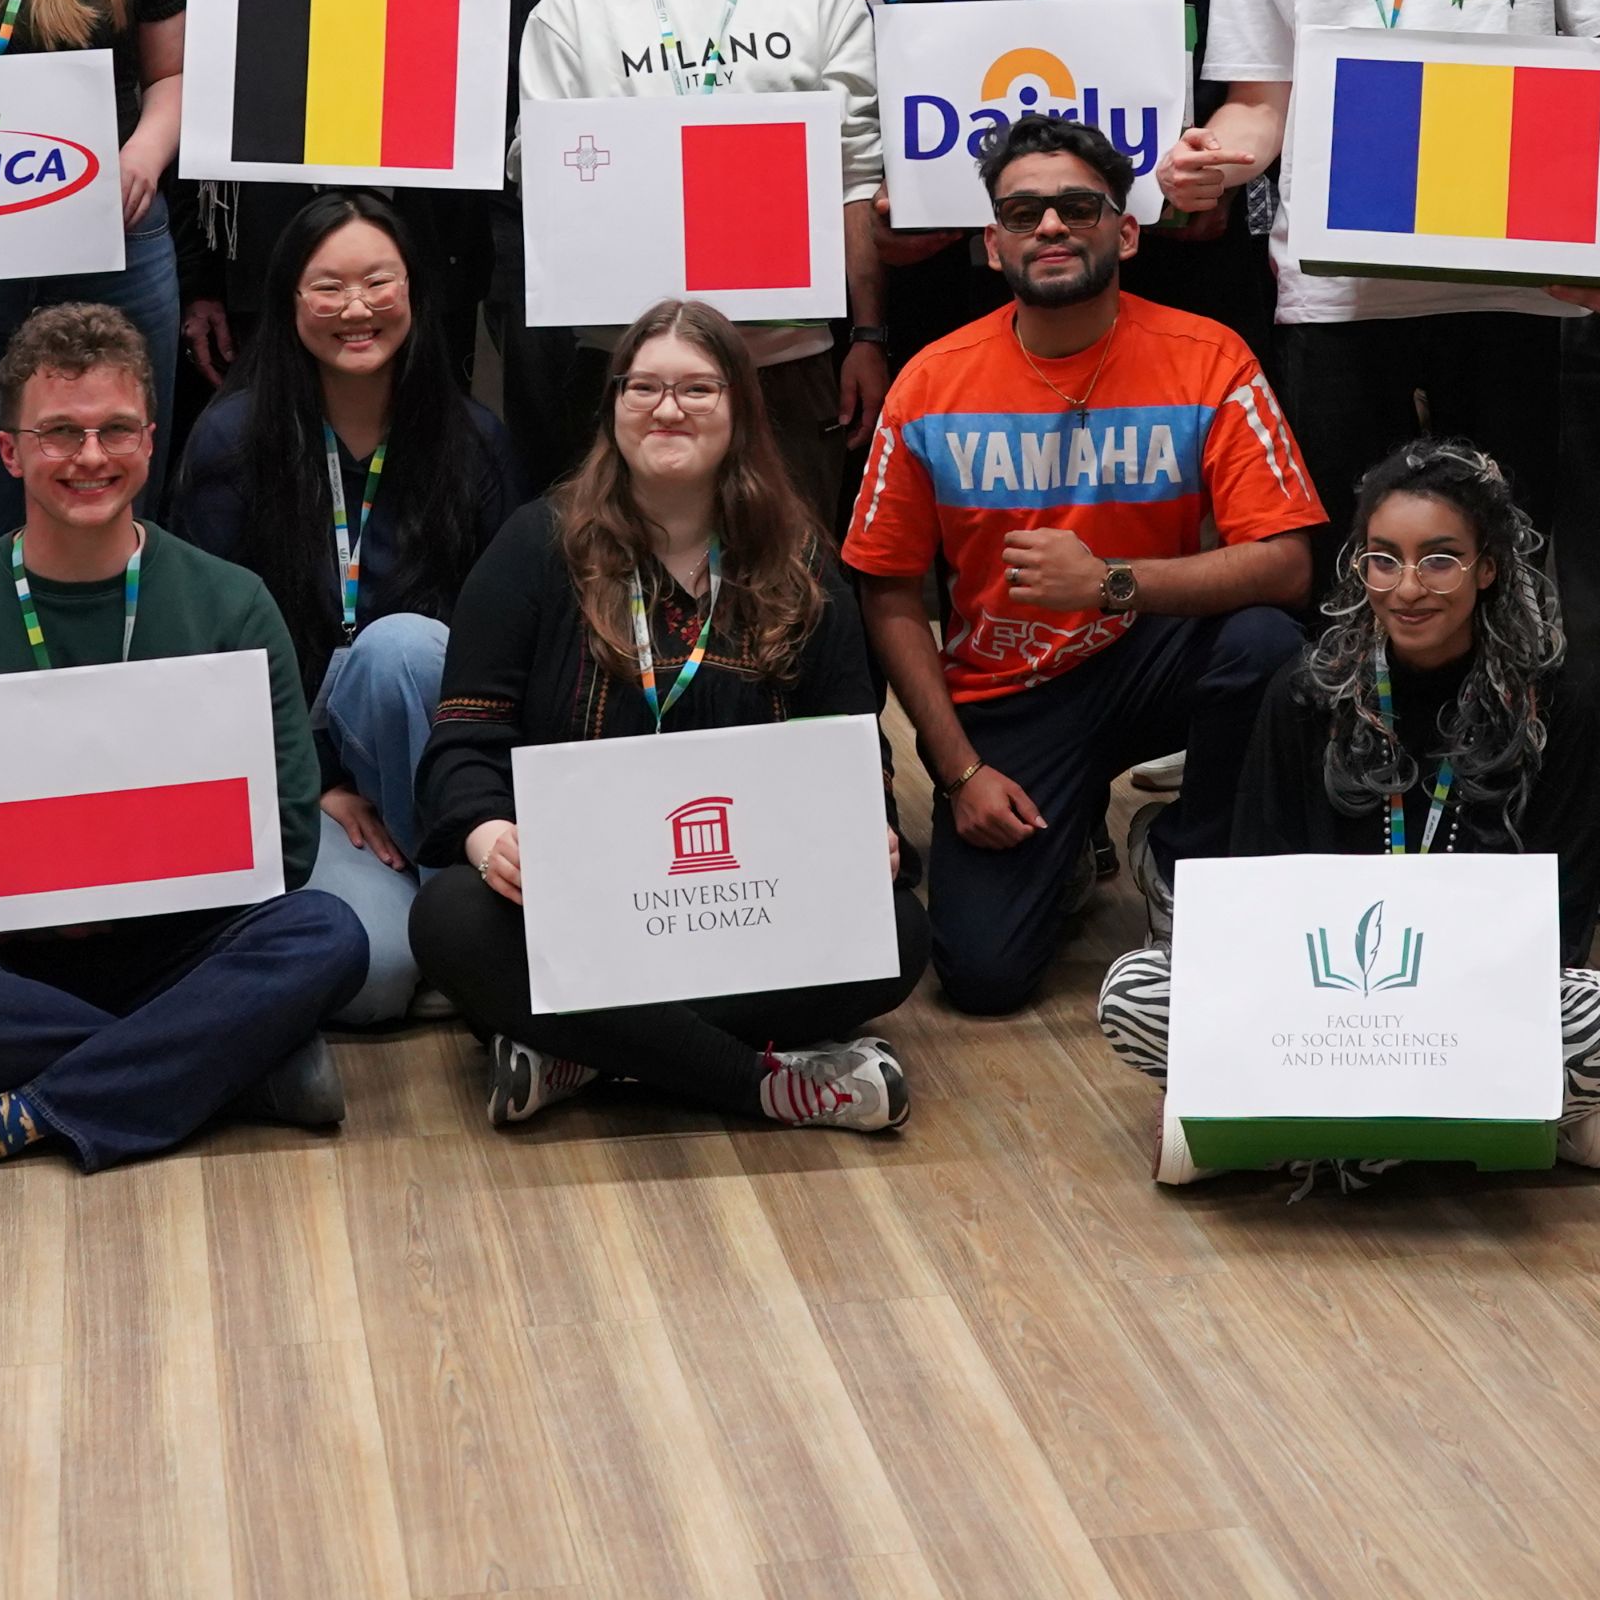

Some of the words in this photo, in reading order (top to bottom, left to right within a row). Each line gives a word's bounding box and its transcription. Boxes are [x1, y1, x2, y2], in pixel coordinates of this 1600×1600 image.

[621, 32, 791, 78] MILANO
[686, 70, 734, 89] ITLY
[904, 88, 1158, 177] Daly
[945, 424, 1183, 491] YAMAHA
[633, 878, 779, 912] UNIVERSITY
[646, 914, 677, 936] OF
[687, 906, 772, 932] LOMZA
[1327, 1014, 1404, 1029] FACULTY
[1271, 1033, 1295, 1048] OF
[1302, 1033, 1366, 1048] SOCIAL
[1372, 1033, 1459, 1048] SCIENCES
[1282, 1052, 1324, 1066] AND
[1331, 1052, 1448, 1067] HUMANITIES
